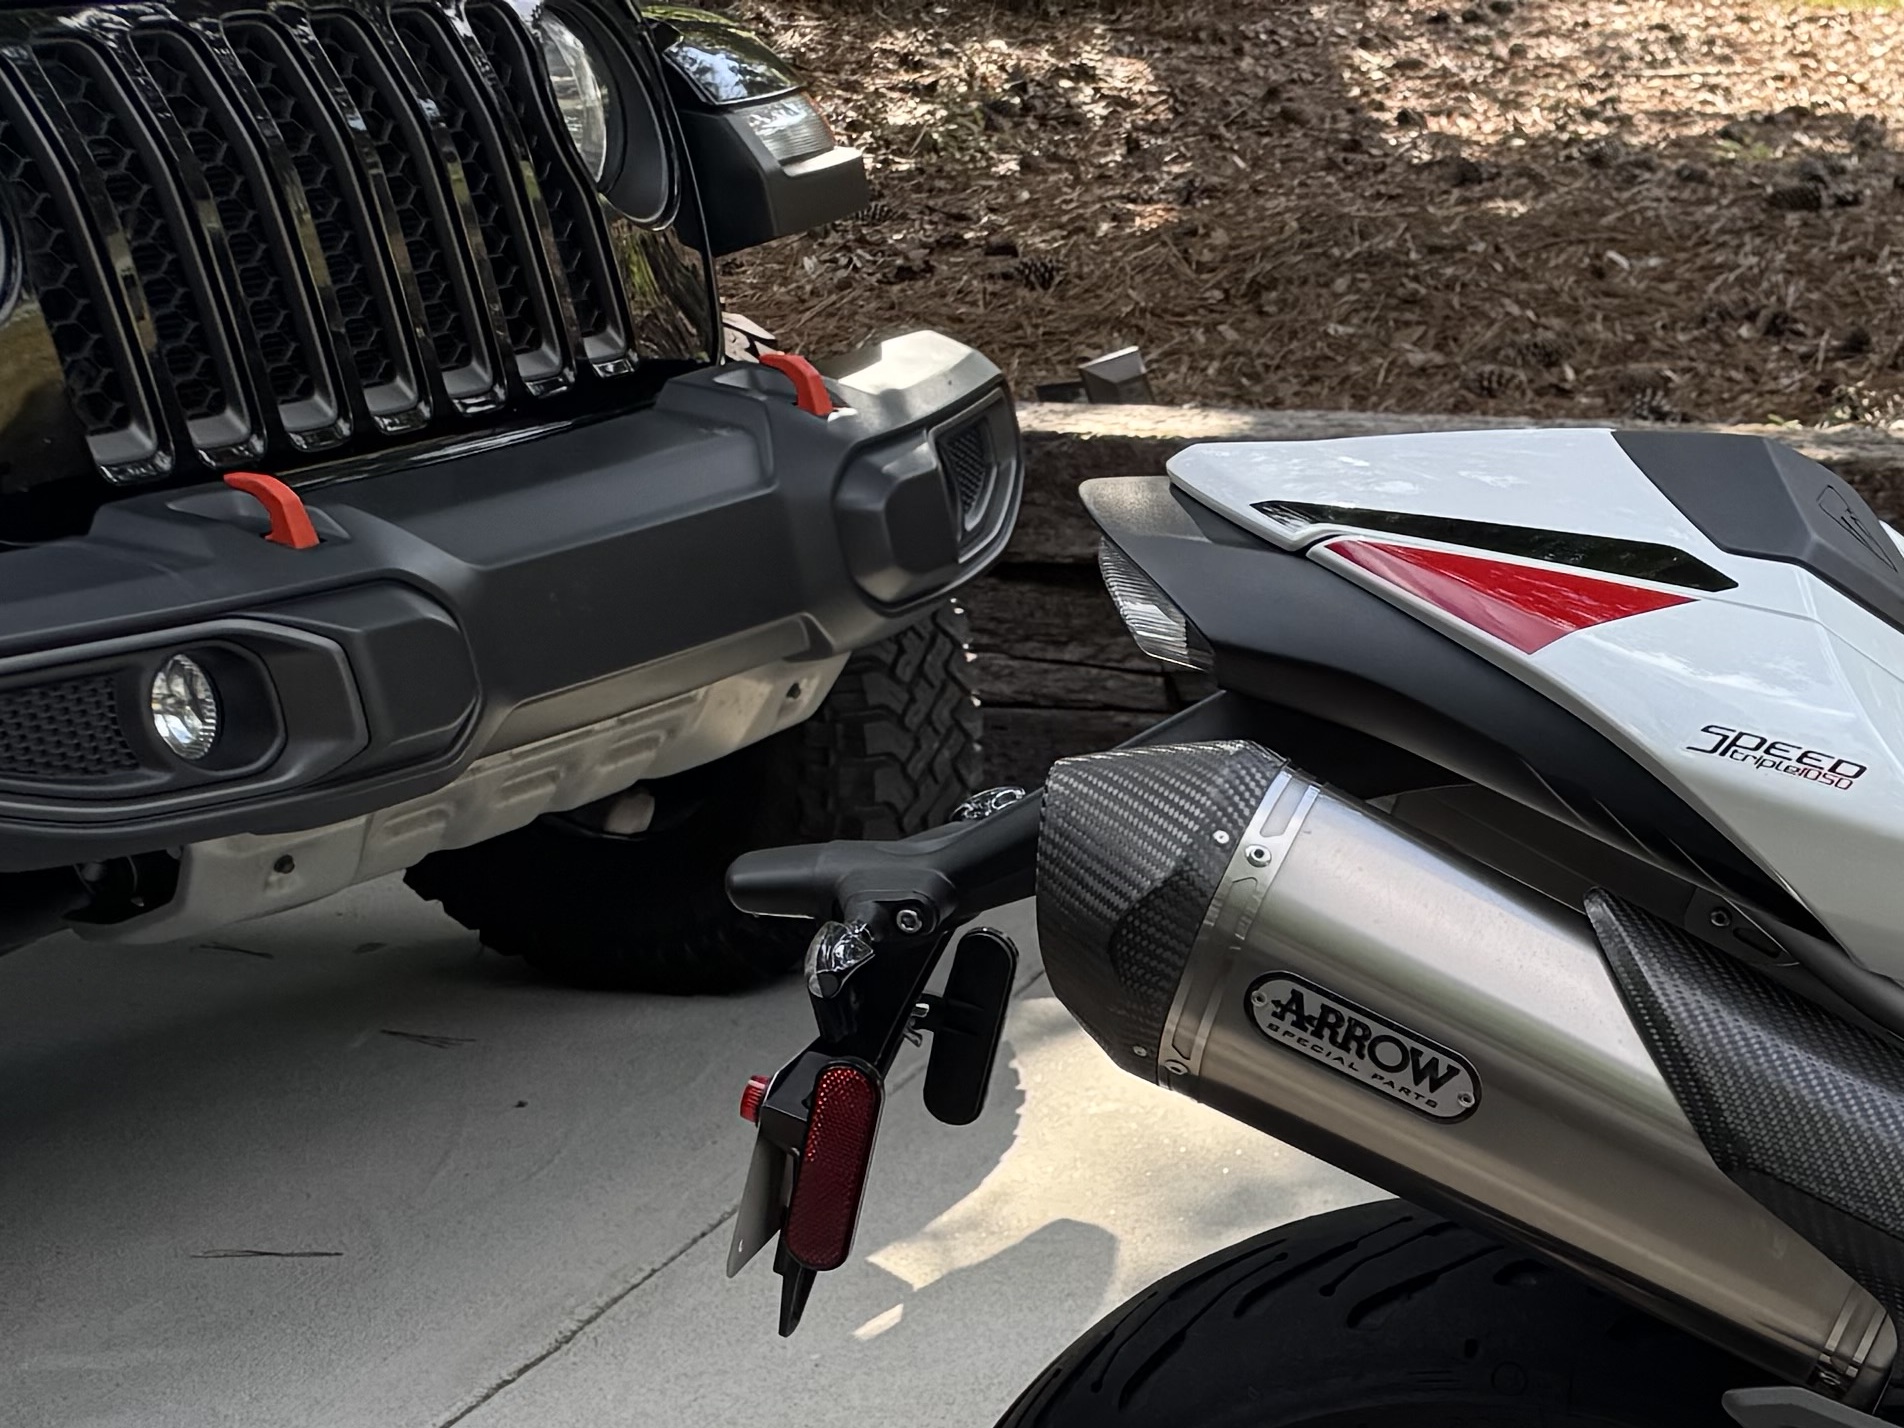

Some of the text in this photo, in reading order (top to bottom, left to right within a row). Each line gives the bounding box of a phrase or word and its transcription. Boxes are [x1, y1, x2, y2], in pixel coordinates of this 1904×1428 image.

[1686, 724, 1867, 780] SPEED
[1267, 1022, 1440, 1110] SPECIAL PARTS
[1271, 988, 1461, 1095] ARROW
